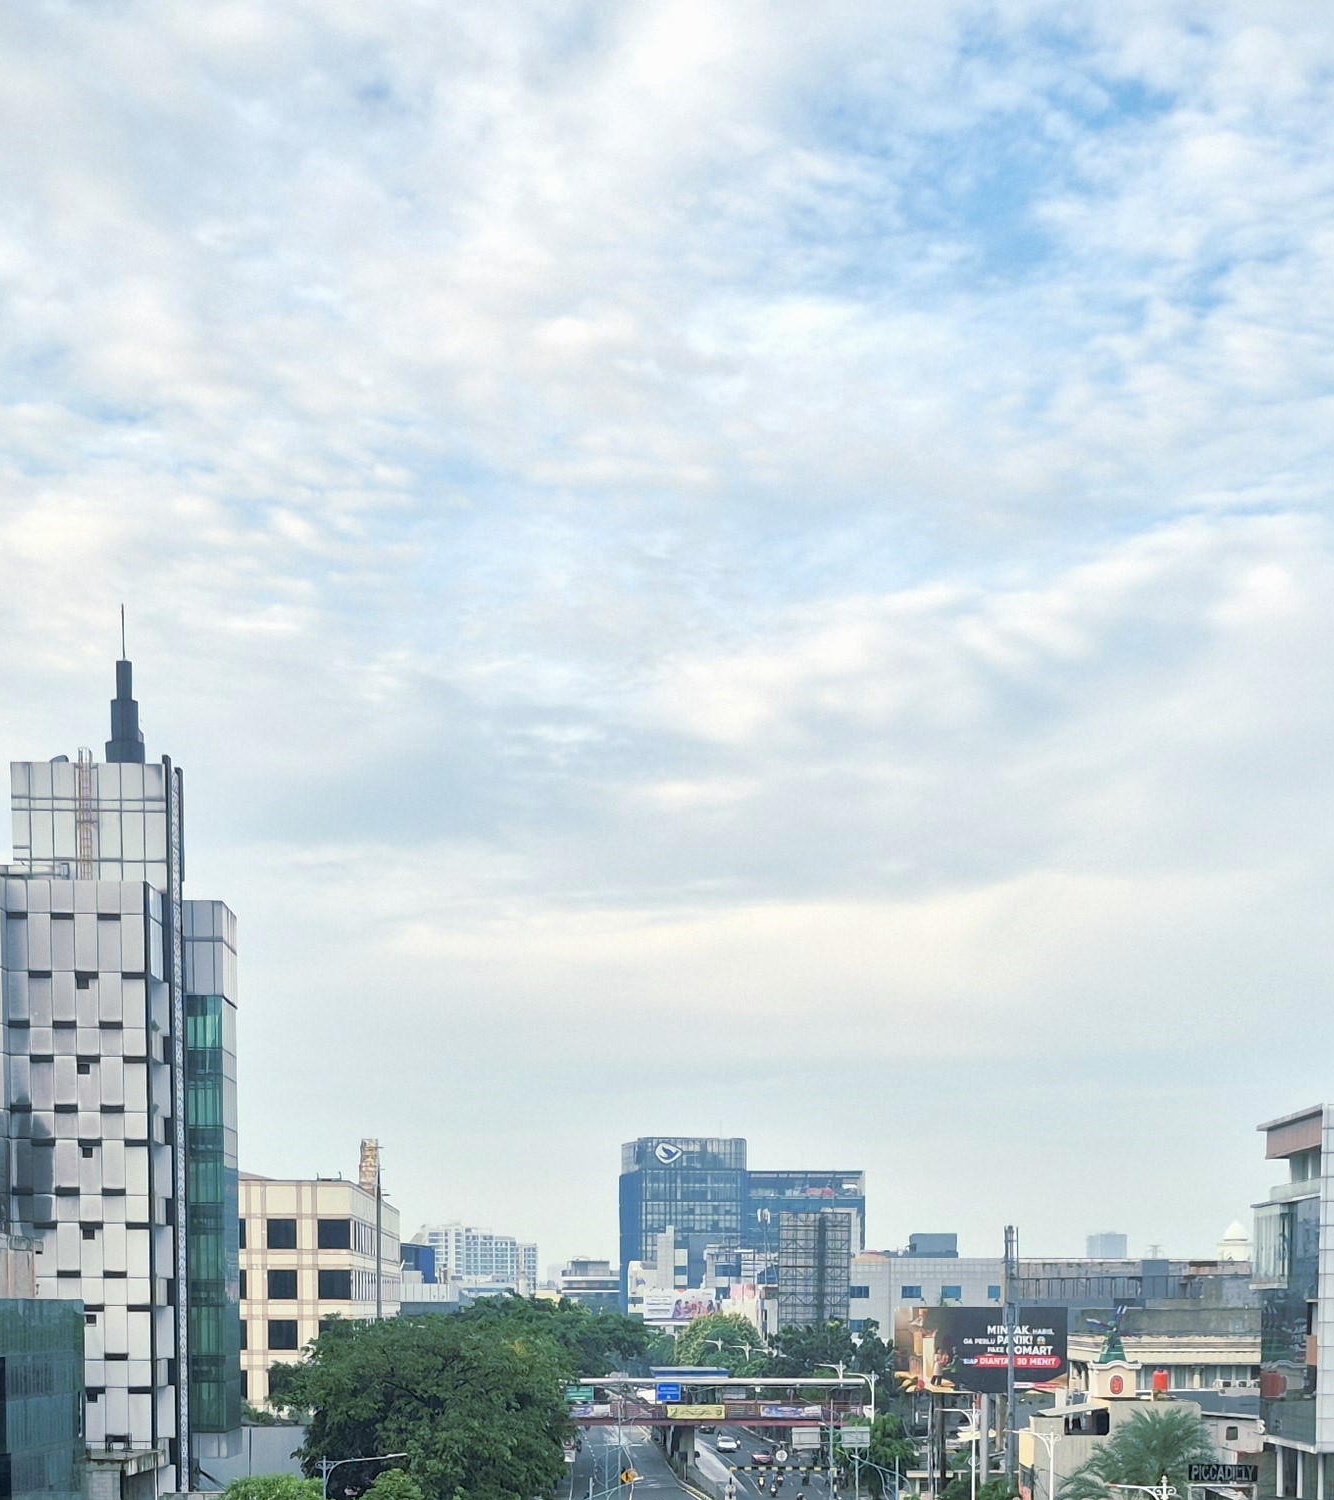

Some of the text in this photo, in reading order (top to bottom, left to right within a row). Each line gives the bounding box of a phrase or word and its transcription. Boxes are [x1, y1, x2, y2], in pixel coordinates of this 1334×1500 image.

[987, 1325, 1029, 1335] MINAK
[979, 1357, 1015, 1365] DIANTA
[1191, 1465, 1254, 1480] PICCADILLY
